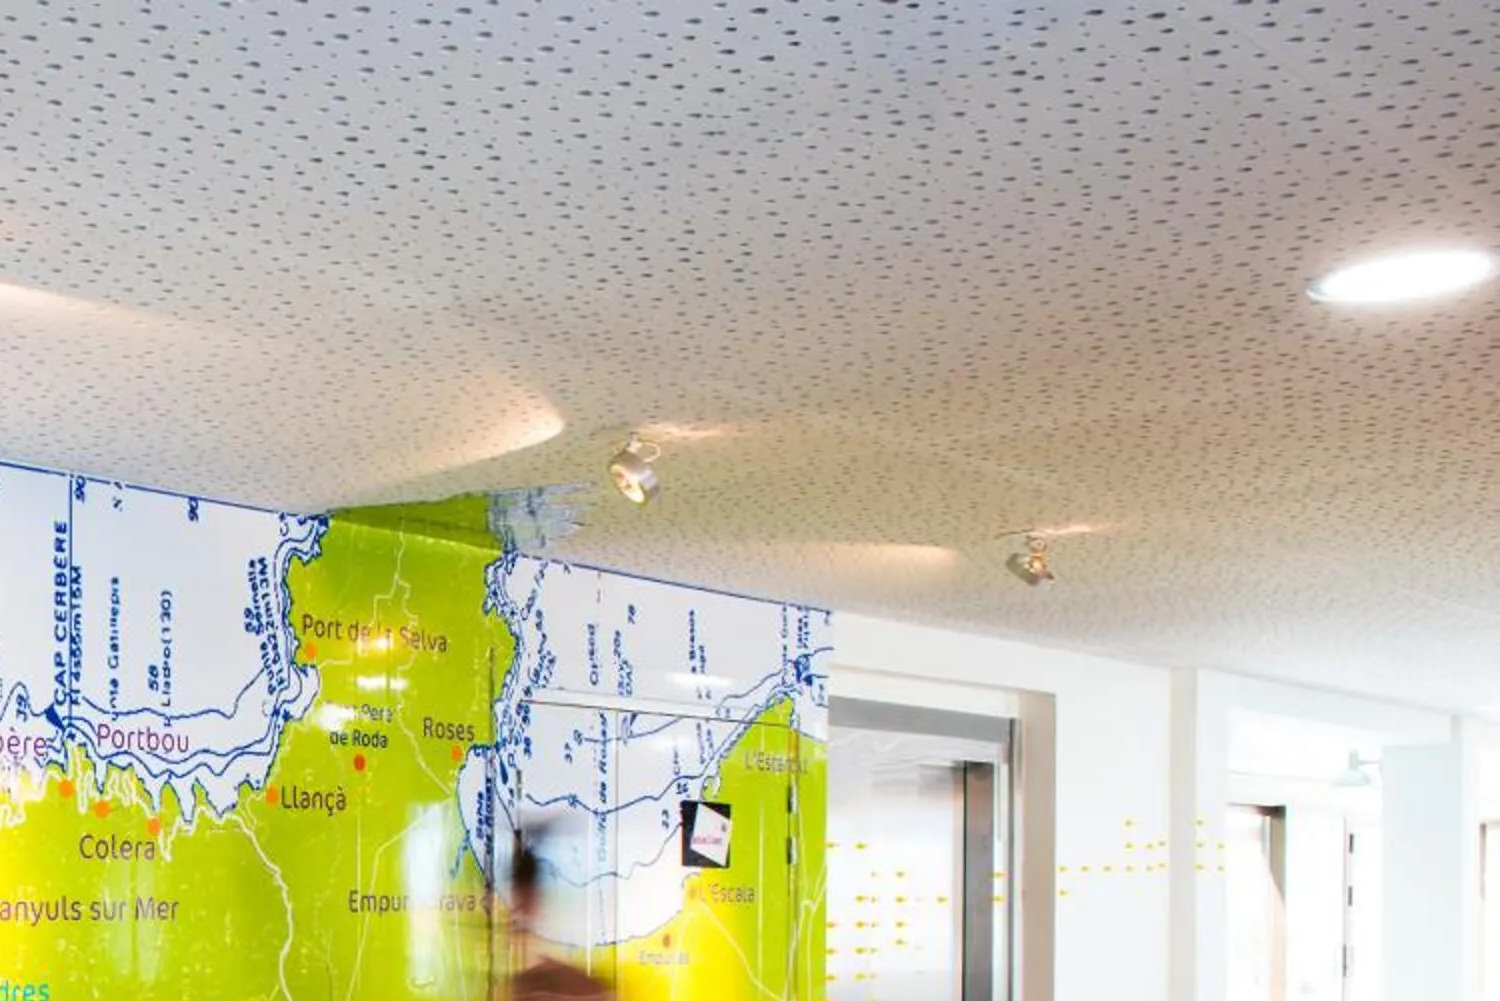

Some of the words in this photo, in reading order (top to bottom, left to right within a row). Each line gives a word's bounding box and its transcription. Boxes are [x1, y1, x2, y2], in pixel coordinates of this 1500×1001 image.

[301, 613, 342, 641] Port
[398, 626, 449, 654] Selva
[53, 651, 68, 707] CAP
[97, 723, 191, 755] Portbou
[352, 731, 389, 749] Roda
[423, 716, 476, 743] Roses
[280, 784, 348, 816] Llançà
[78, 836, 156, 861] Colera
[88, 901, 129, 922] sur
[134, 898, 180, 922] Mer
